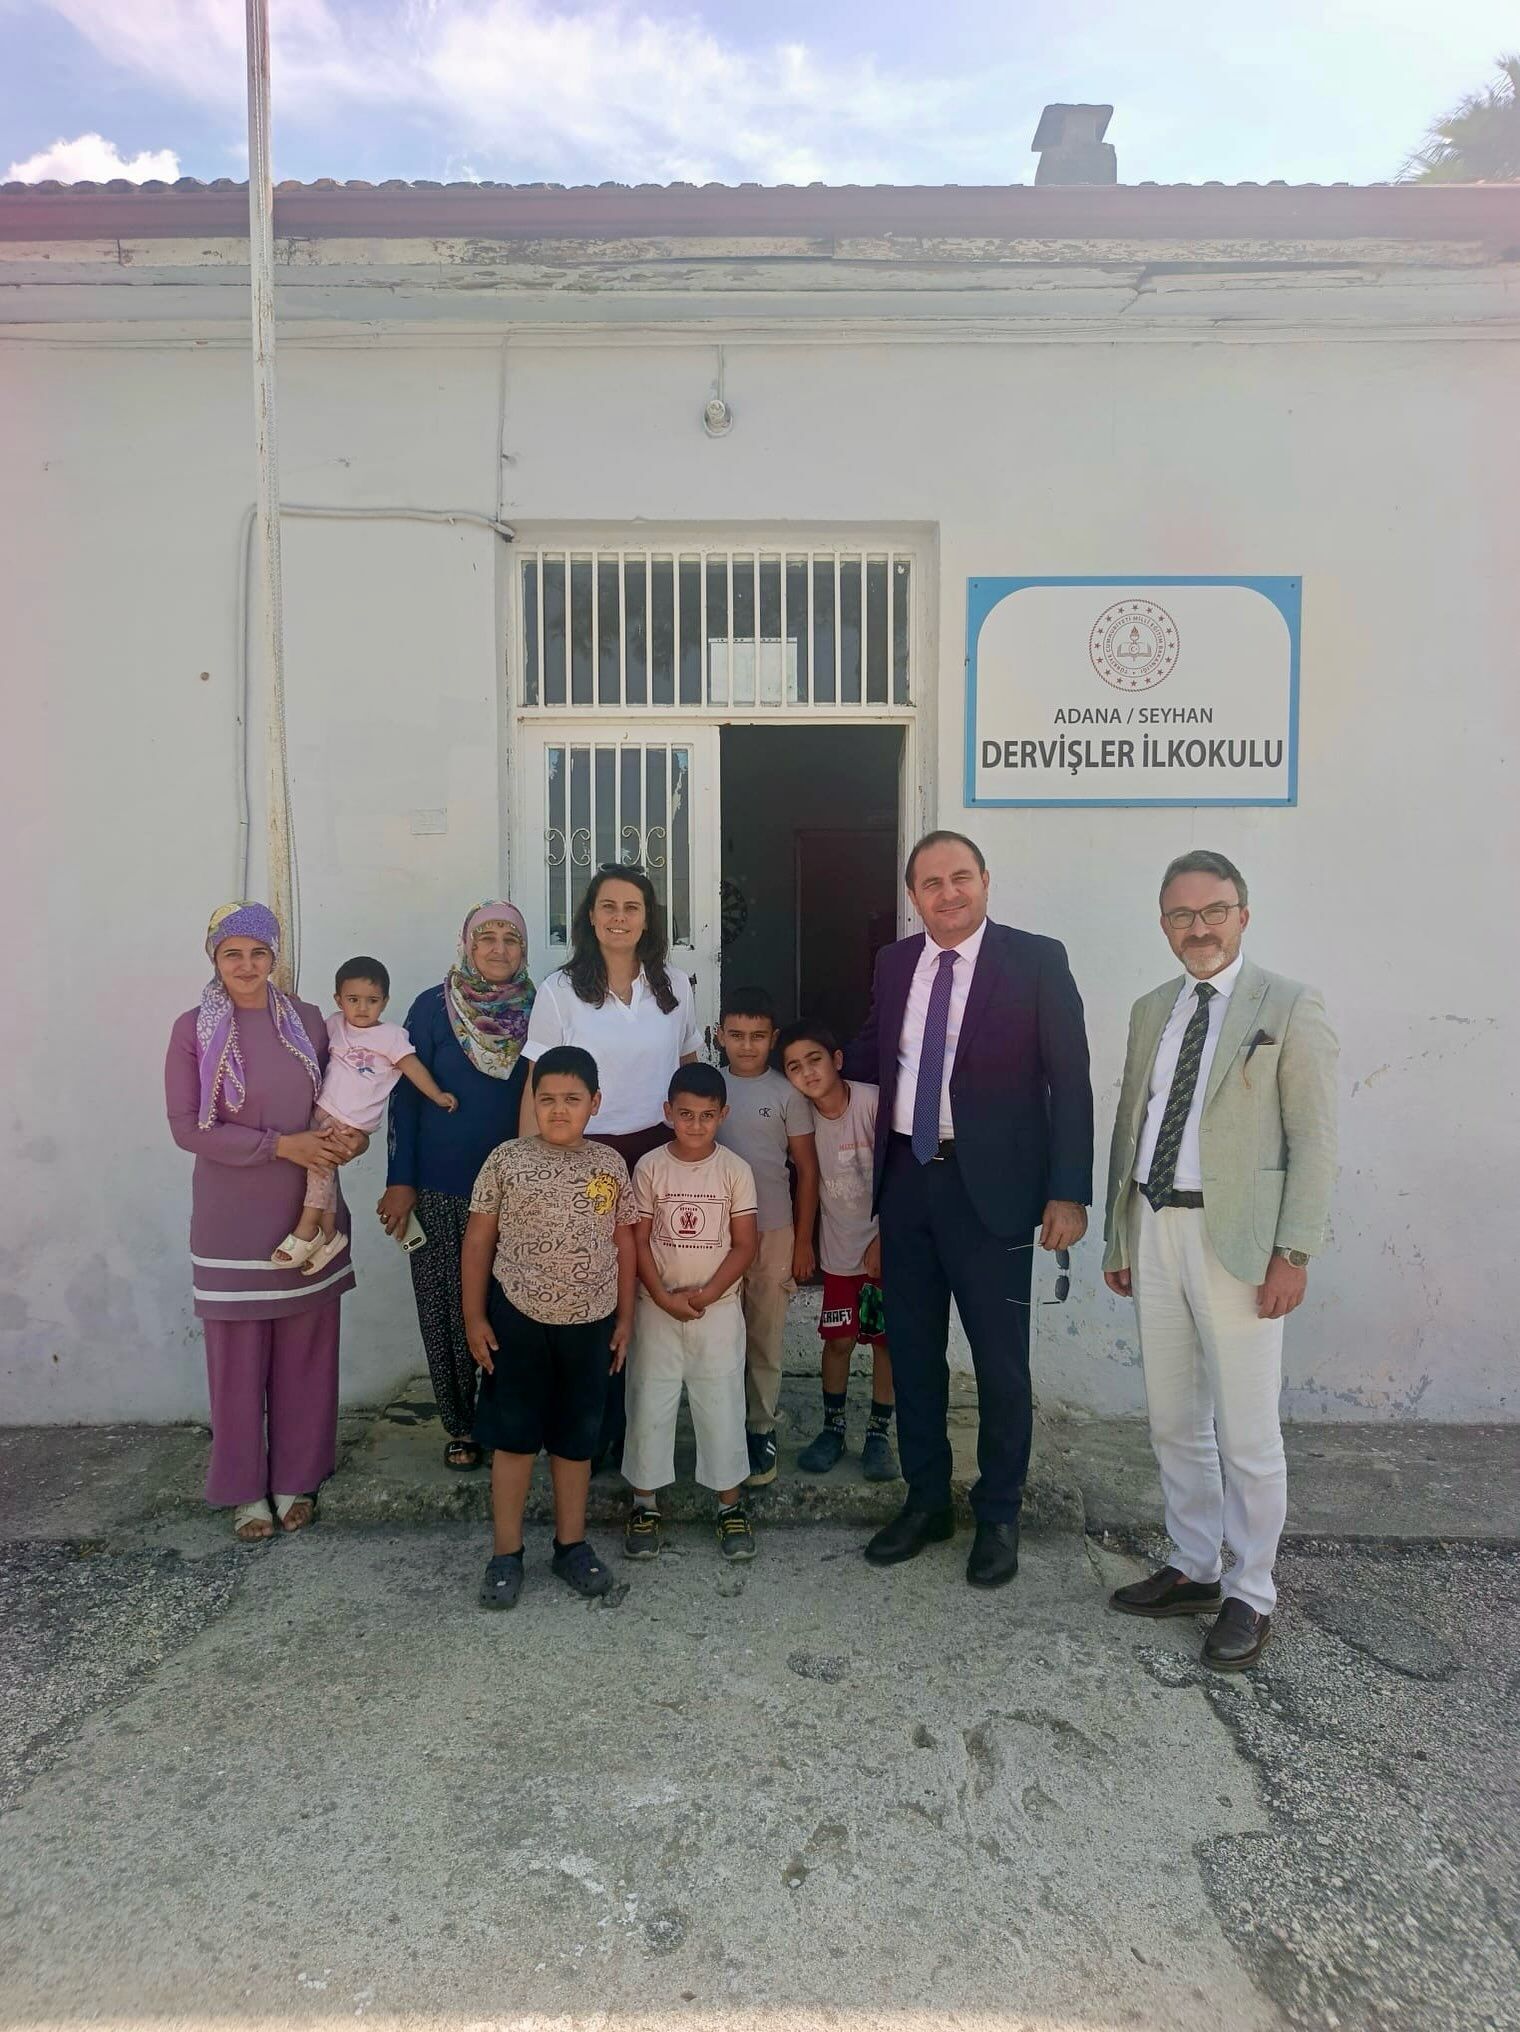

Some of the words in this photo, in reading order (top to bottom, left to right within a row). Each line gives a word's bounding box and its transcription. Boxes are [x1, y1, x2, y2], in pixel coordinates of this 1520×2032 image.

[1054, 707, 1122, 724] ADANA
[1126, 707, 1134, 725] /
[1138, 707, 1213, 724] SEYHAN
[981, 733, 1135, 776] DERVİŞLER
[1142, 732, 1283, 768] İLKOKULU
